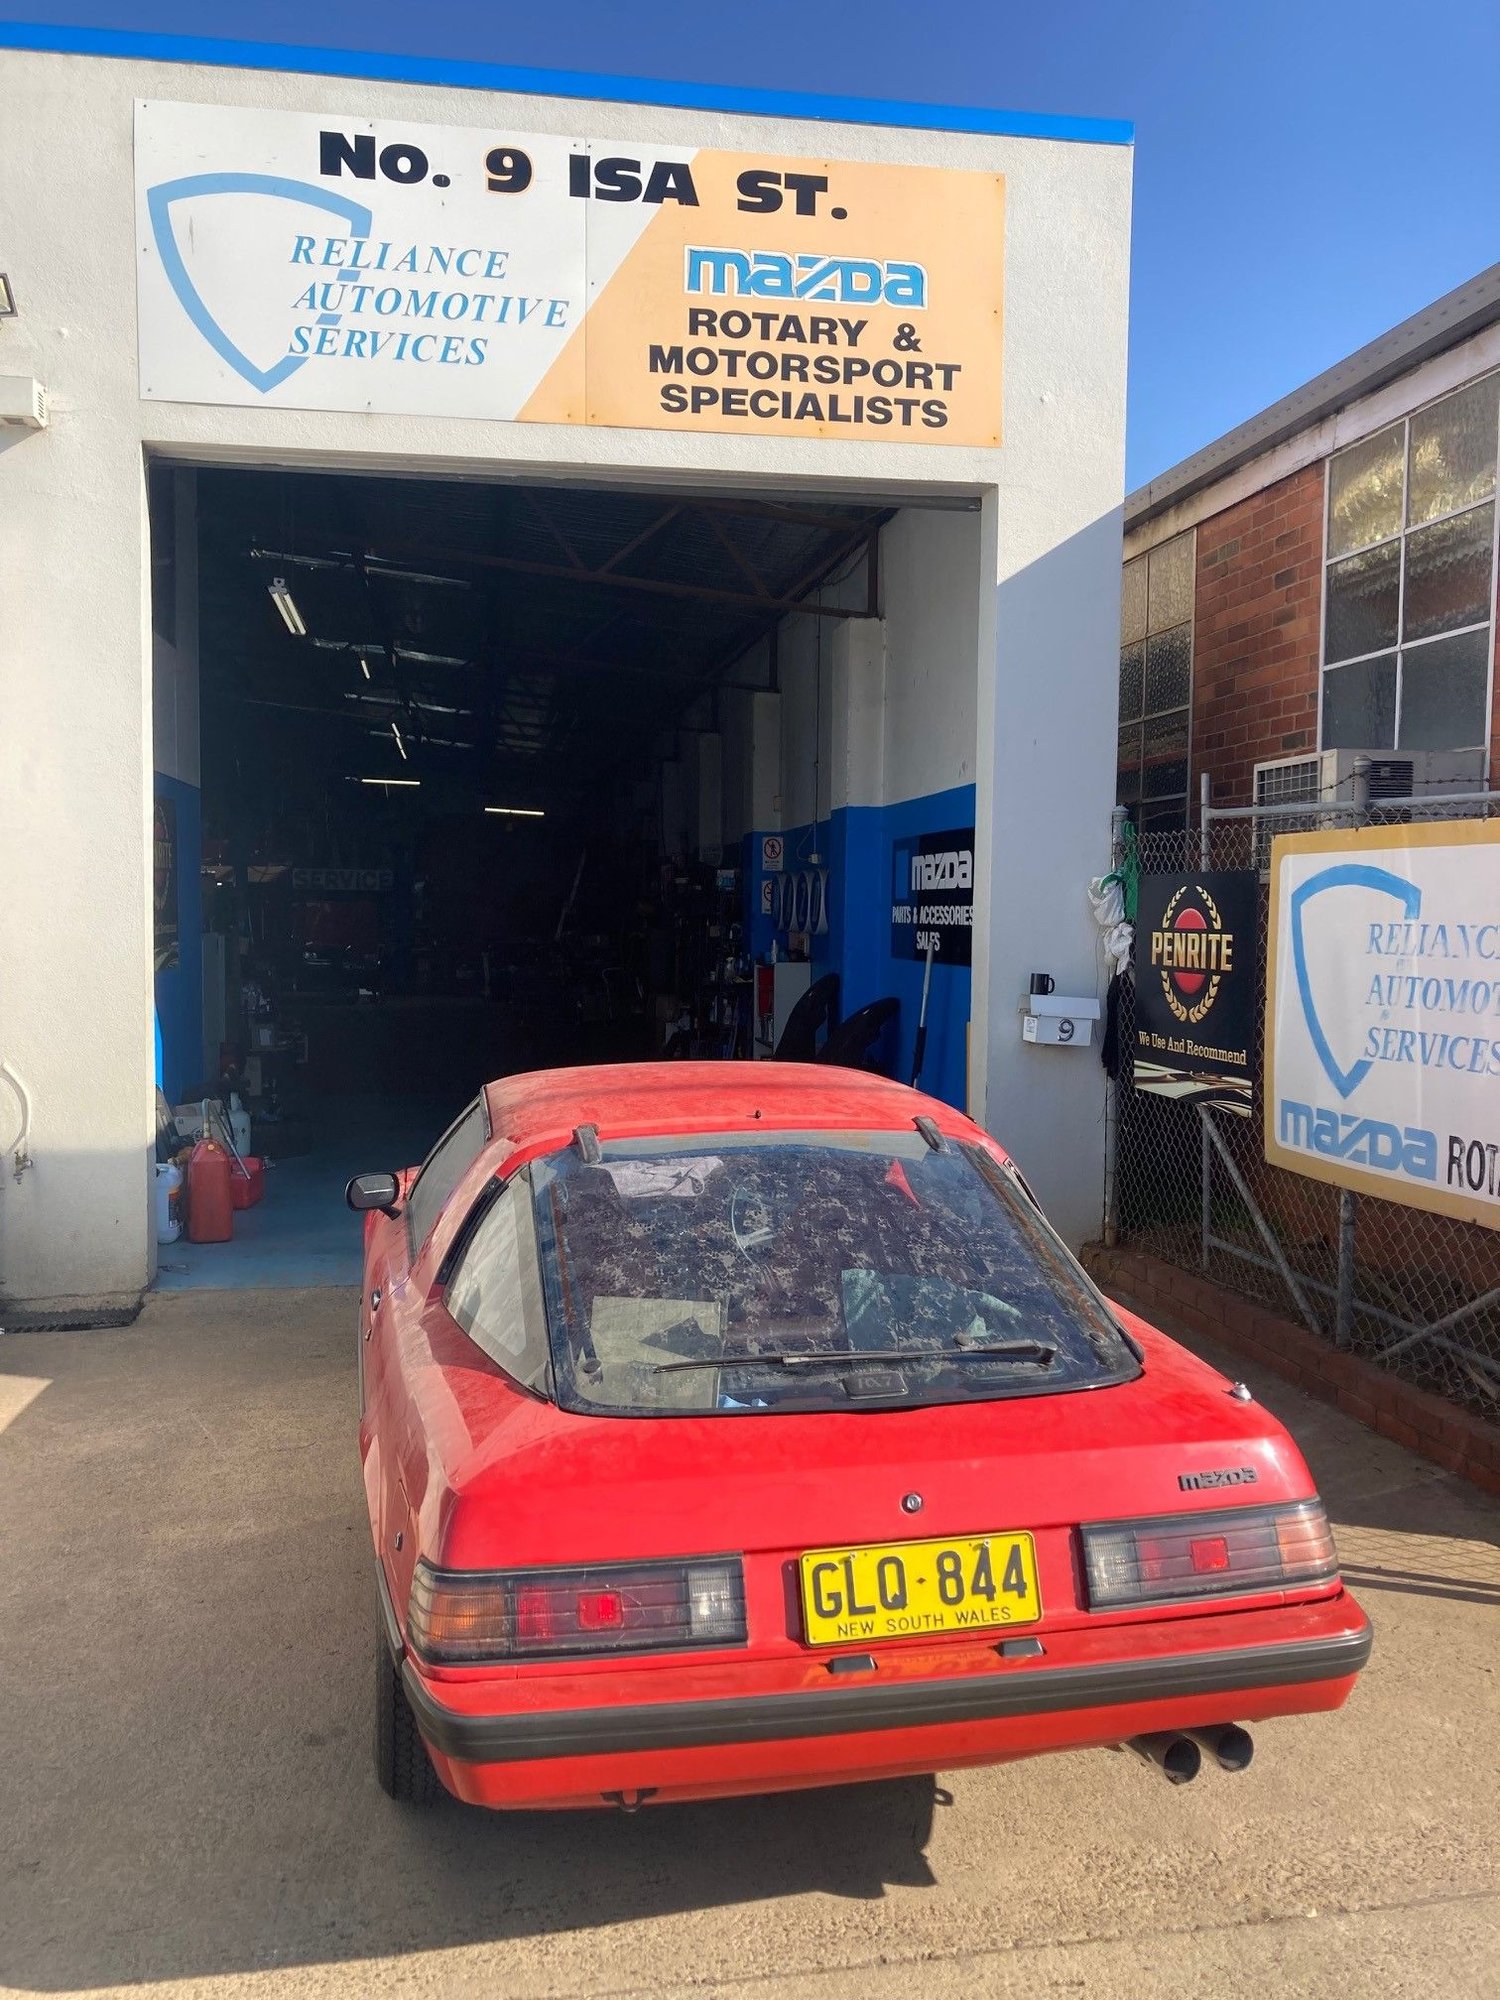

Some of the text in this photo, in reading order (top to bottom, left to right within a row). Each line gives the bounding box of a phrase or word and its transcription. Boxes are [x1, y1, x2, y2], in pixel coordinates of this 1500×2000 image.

[319, 130, 848, 220] No. 9 ISA ST.
[288, 235, 510, 279] RELIANCE
[684, 246, 928, 310] mazda
[290, 281, 571, 328] AUTOMOTIVE
[288, 325, 489, 366] SERVICES
[688, 307, 923, 353] ROTARY &
[649, 344, 962, 392] MOTORSPORT
[659, 383, 949, 428] SPECIALISTS
[911, 850, 973, 891] mazda
[892, 905, 974, 926] PARTS & ACCESSORIES
[916, 931, 941, 951] SALES
[1151, 931, 1233, 972] PENRITE
[1365, 923, 1500, 960] RELIANC
[1057, 1018, 1075, 1042] 9
[1138, 1030, 1247, 1066] We Use And Recommend
[1280, 1098, 1500, 1198] mazda ROT
[837, 1606, 1012, 1638] NEW SOUTH WALES
